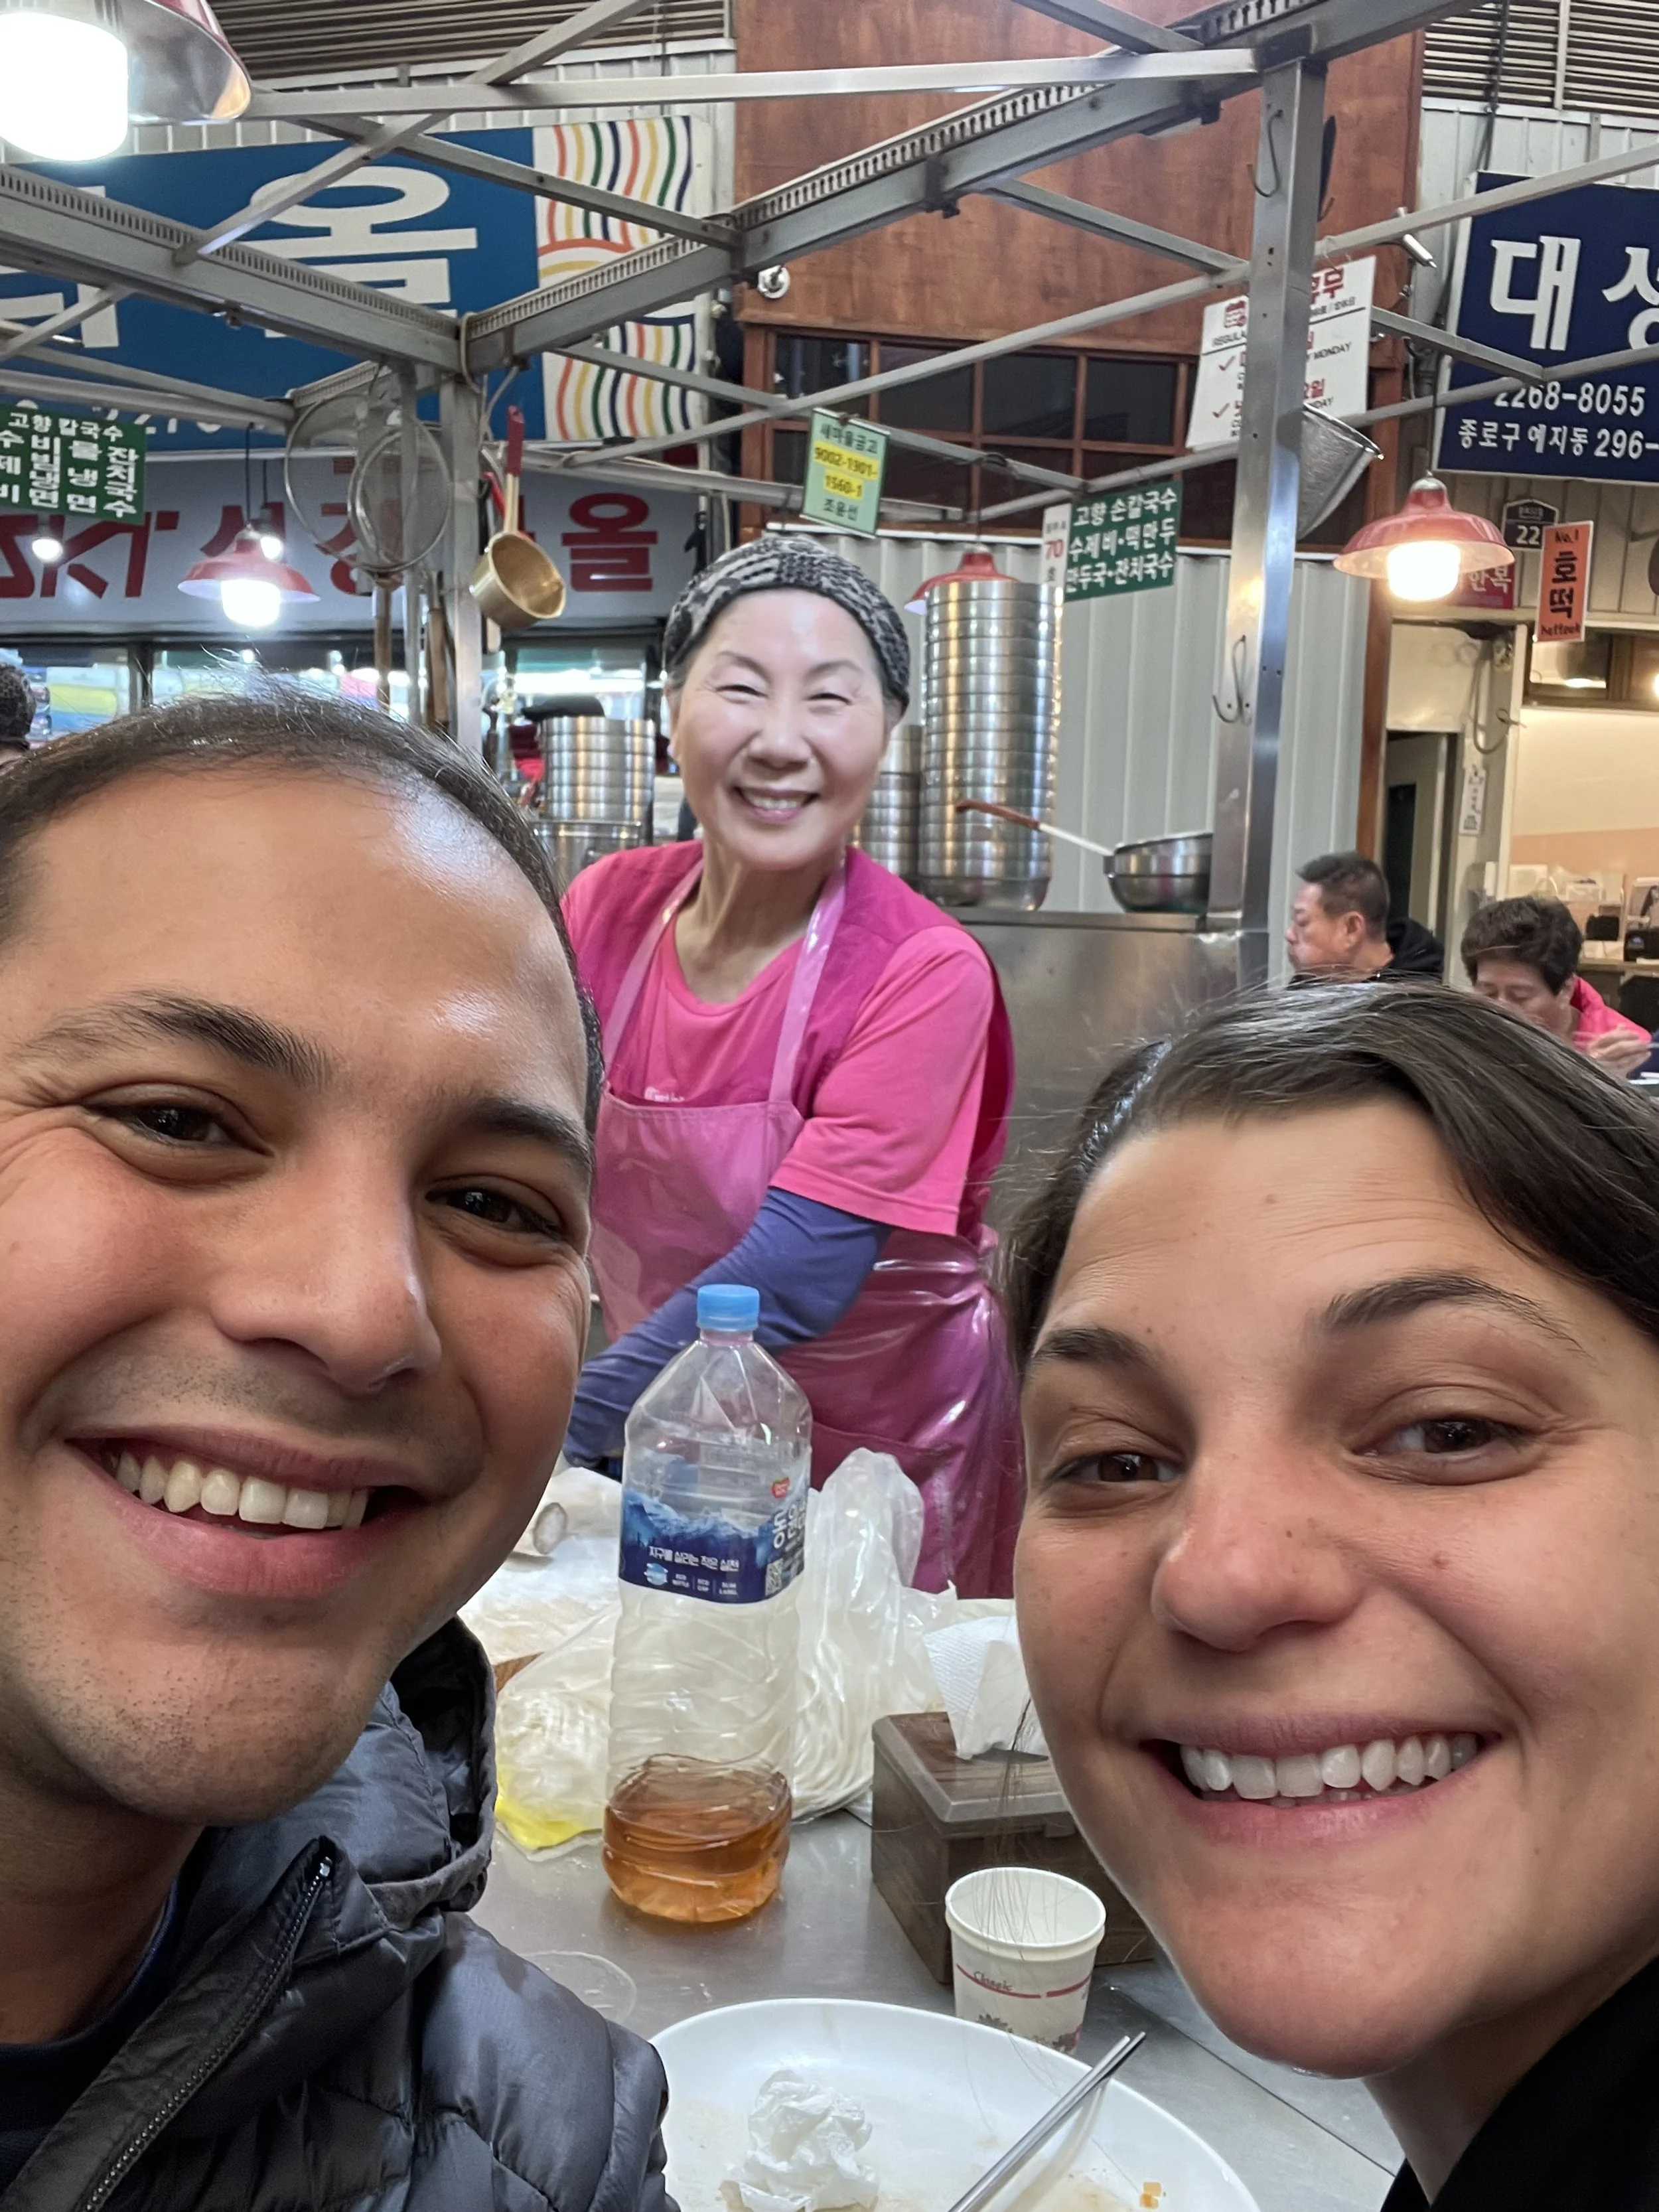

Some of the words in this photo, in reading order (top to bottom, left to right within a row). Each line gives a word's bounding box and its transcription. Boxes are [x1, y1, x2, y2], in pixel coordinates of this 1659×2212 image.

[8, 412, 52, 433] 고향
[58, 417, 123, 442] 칼국수
[1459, 419, 1520, 452] 종로구
[1528, 423, 1589, 457] 예지동
[103, 446, 139, 518] 잔치국수
[1072, 502, 1107, 526] 고향
[1110, 487, 1178, 522] 손칼국수
[1516, 525, 1540, 544] 22
[1549, 551, 1578, 619] 호떡
